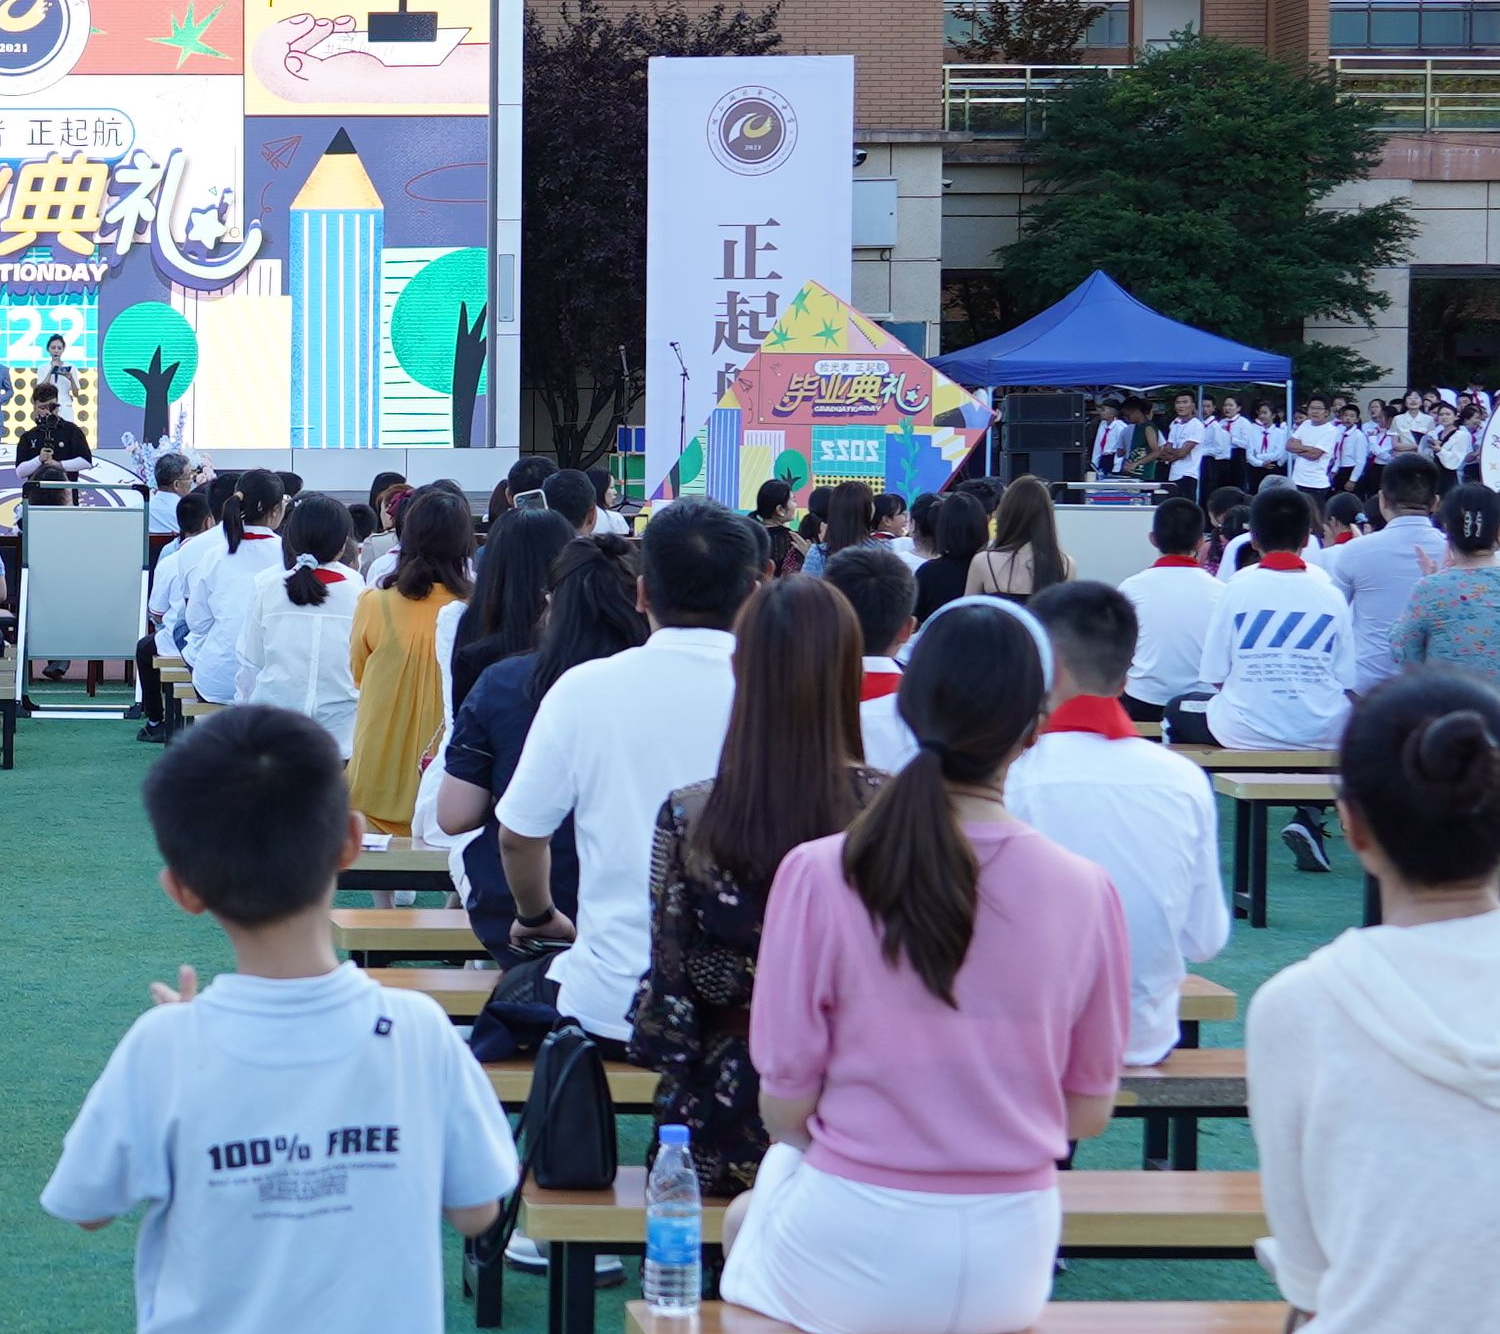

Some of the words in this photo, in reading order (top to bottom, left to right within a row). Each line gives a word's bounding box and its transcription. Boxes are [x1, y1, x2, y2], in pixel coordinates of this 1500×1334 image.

[28, 117, 124, 148] 正起航
[774, 373, 930, 412] 毕业典礼
[208, 1134, 311, 1170] 100%
[327, 1125, 400, 1157] FREE
